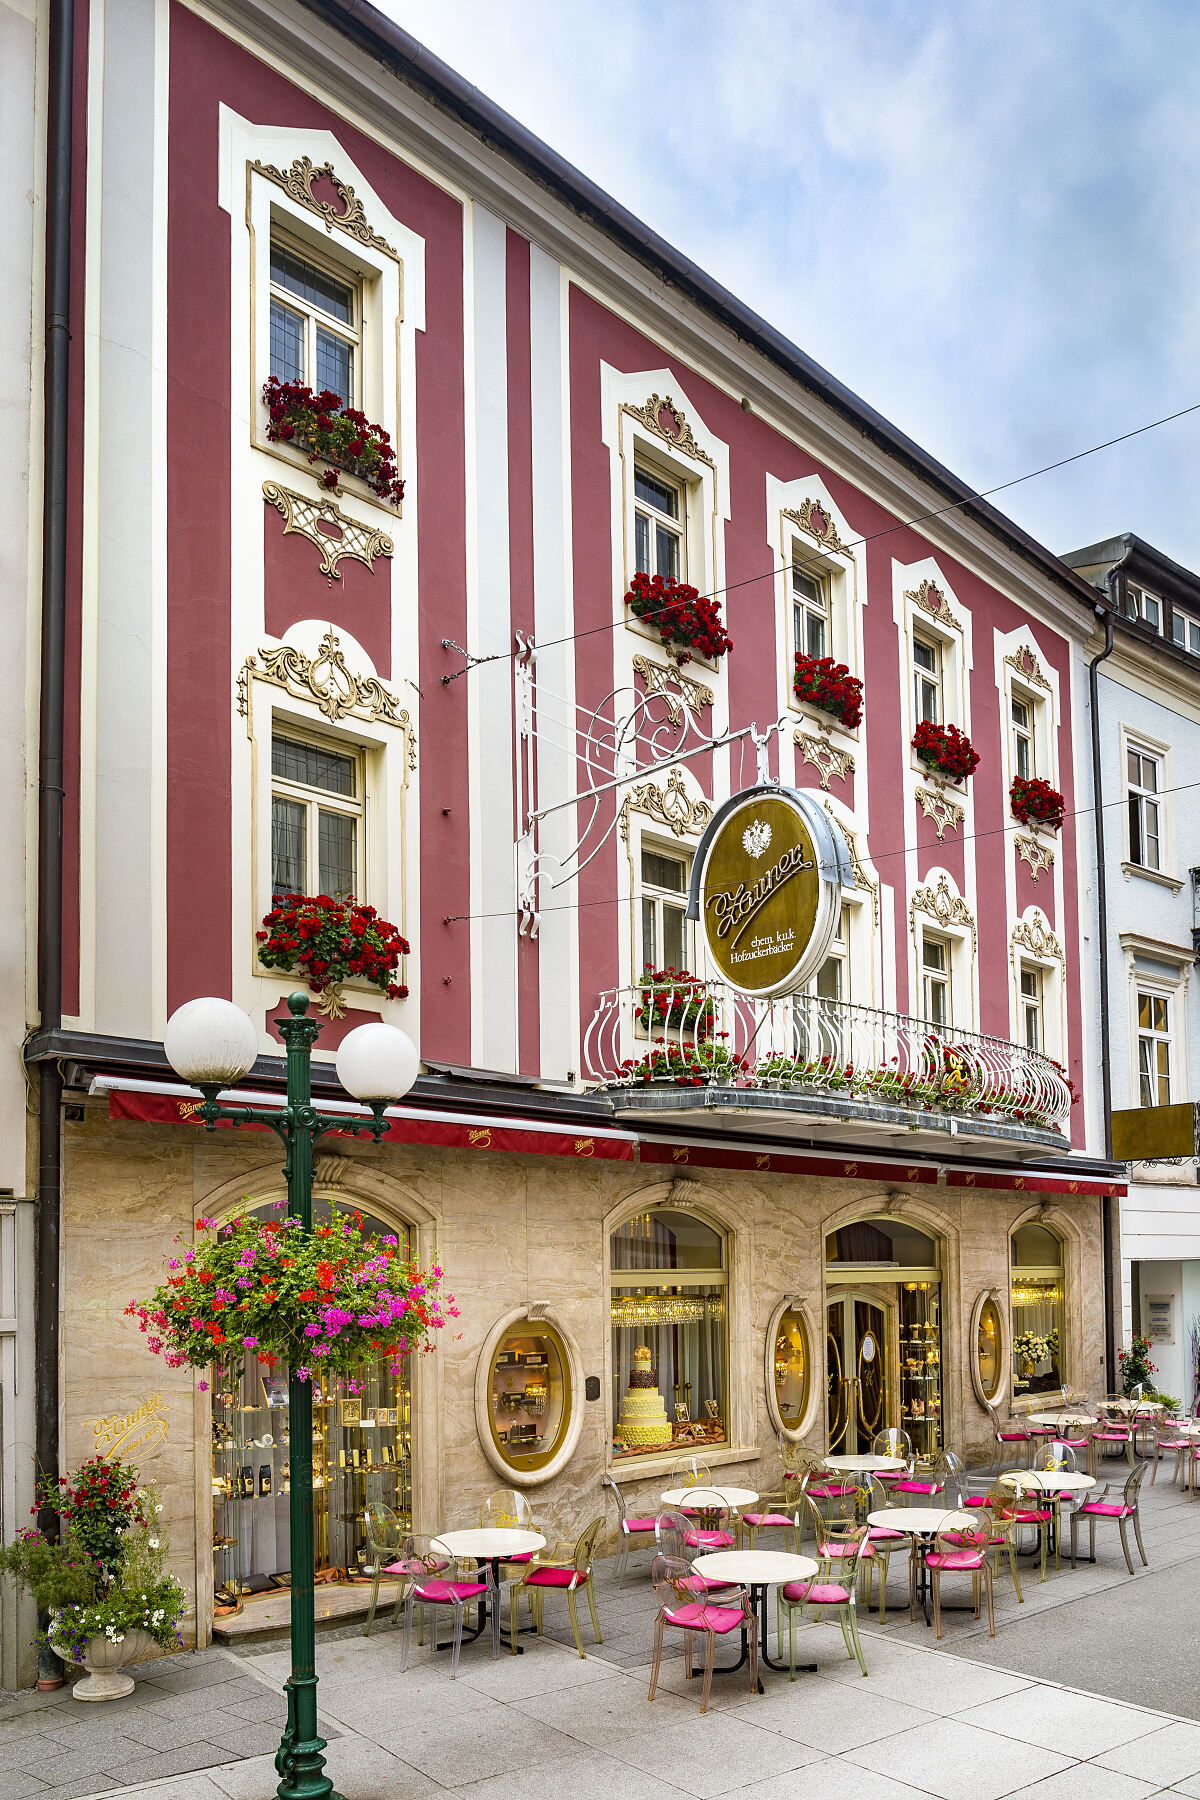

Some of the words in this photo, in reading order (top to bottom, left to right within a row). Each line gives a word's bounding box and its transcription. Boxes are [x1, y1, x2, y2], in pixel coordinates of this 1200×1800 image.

[706, 843, 813, 944] Zauner
[730, 940, 795, 964] Hofzuckerbäcker
[751, 935, 775, 948] ehem.
[84, 1393, 170, 1458] Zauner
